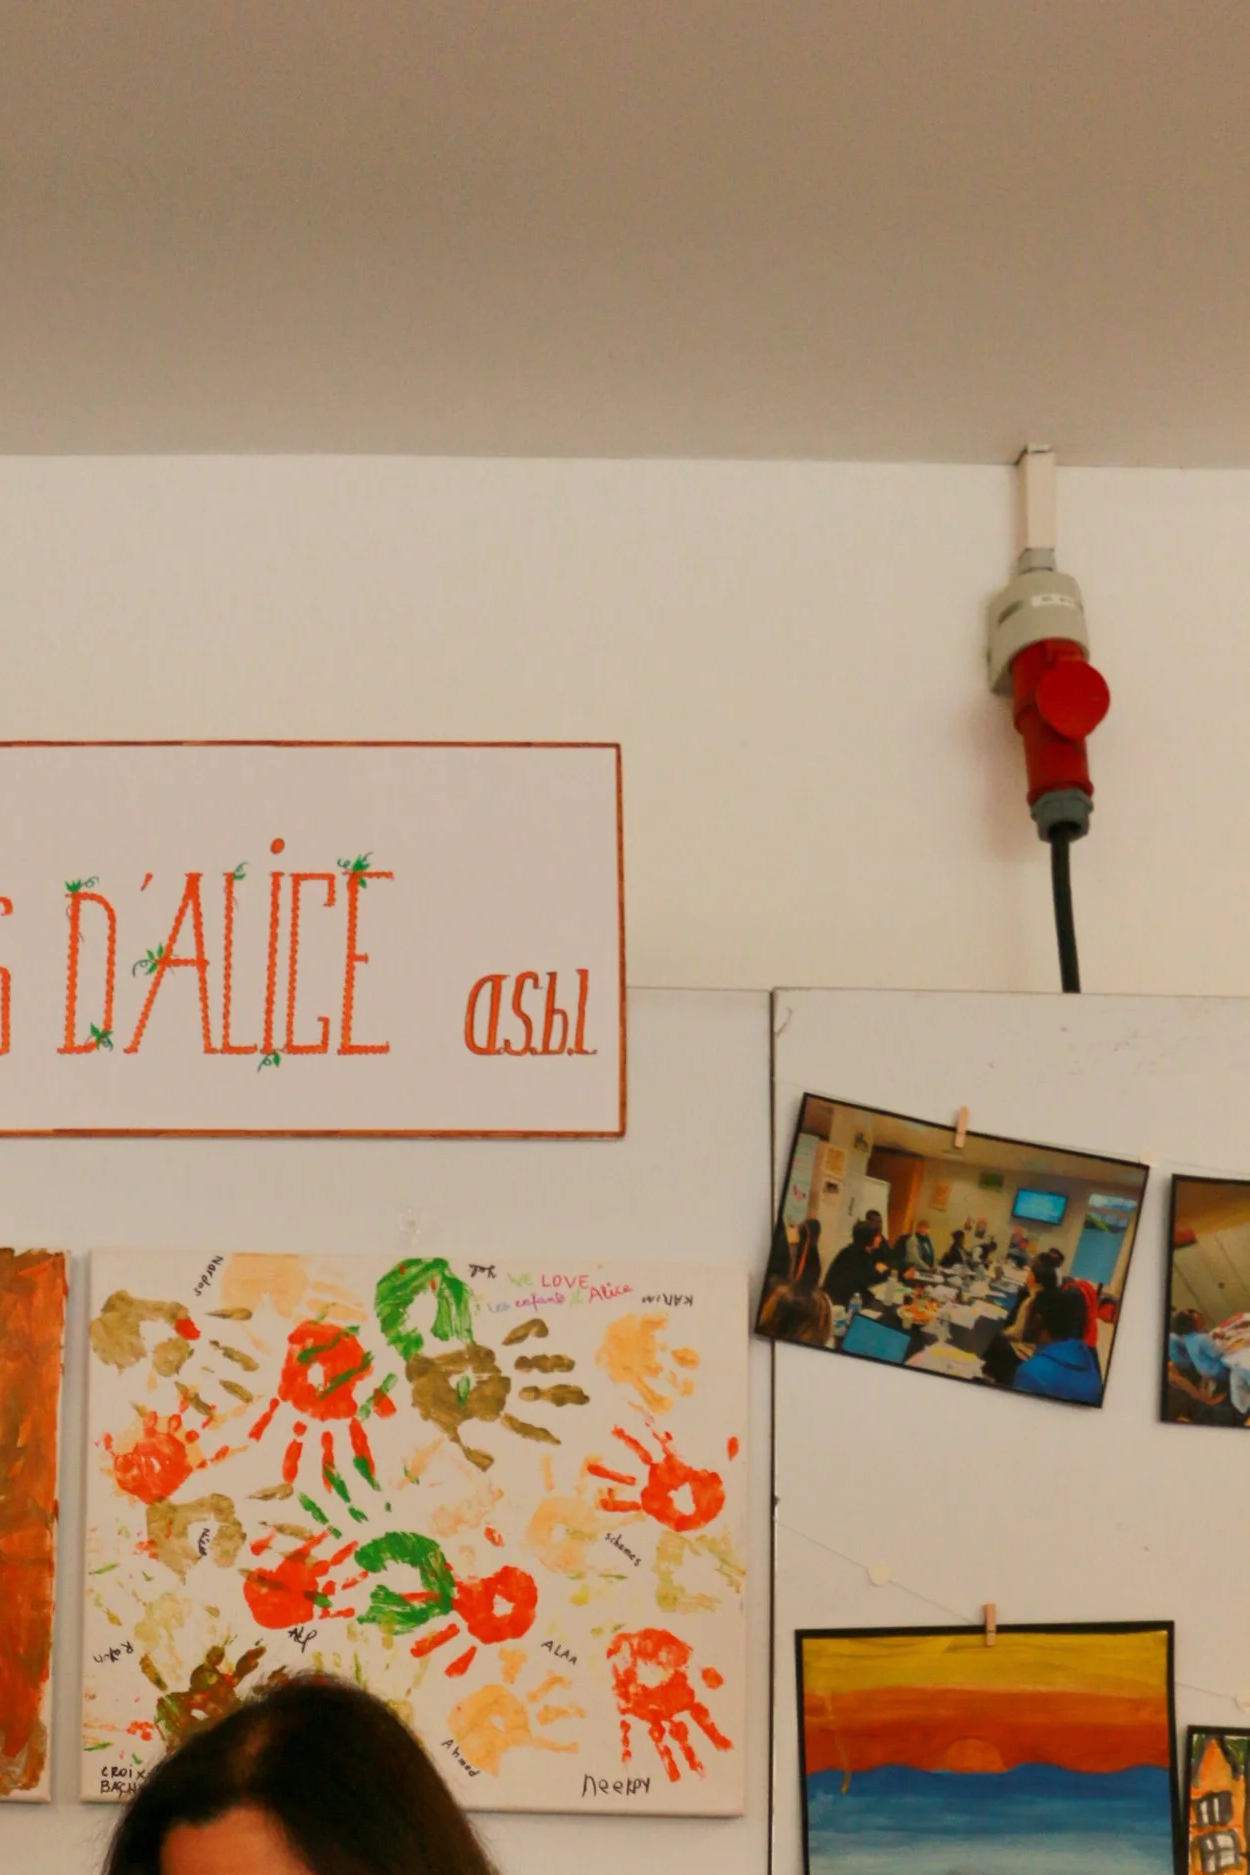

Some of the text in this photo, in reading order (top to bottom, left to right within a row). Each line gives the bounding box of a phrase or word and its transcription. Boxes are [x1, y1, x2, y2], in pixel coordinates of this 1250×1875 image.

[541, 1274, 590, 1290] LOVE
[514, 1292, 566, 1312] enfants
[589, 1283, 633, 1303] Alice
